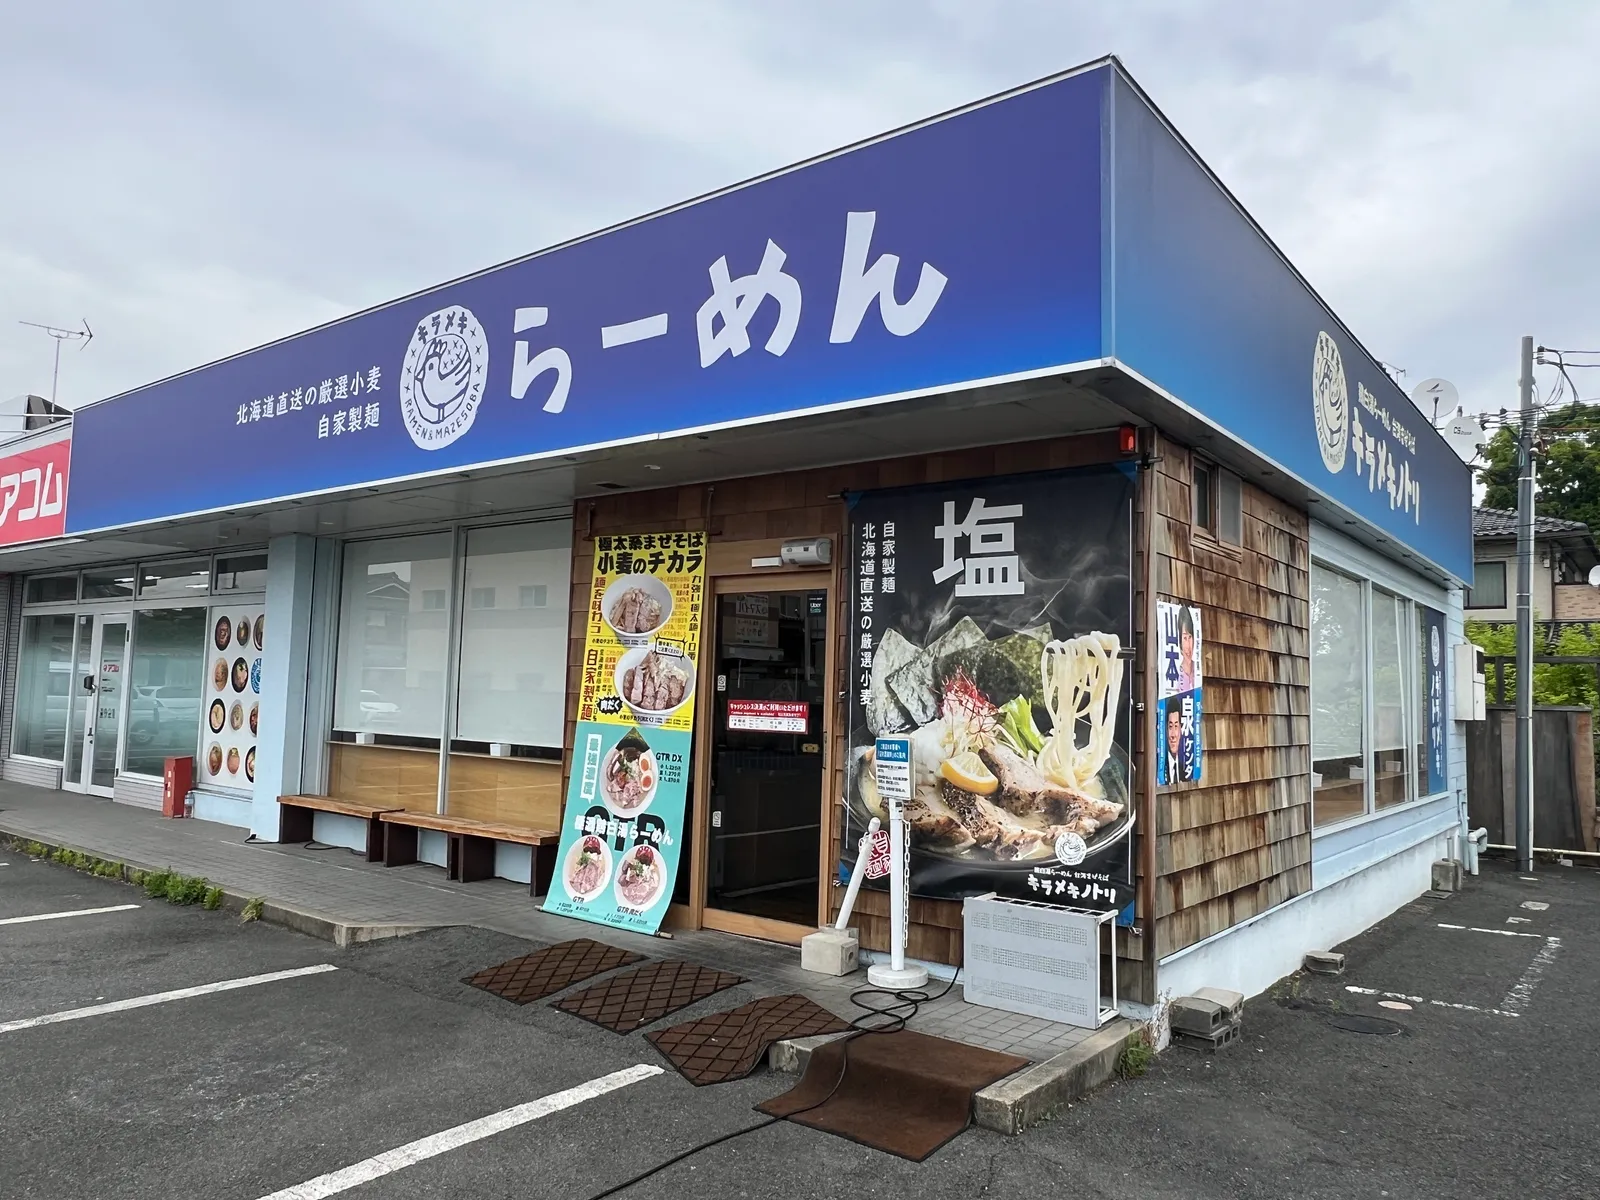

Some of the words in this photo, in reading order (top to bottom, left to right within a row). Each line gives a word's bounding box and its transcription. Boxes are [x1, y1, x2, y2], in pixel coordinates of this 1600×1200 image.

[417, 311, 468, 344] キラメキ
[511, 211, 948, 414] らーめん
[236, 365, 382, 425] 北海道直送の厳選小麦
[317, 402, 380, 439] 自家製麺
[0, 462, 63, 527] アコム
[1352, 407, 1420, 525] キラメキノトリ
[597, 550, 703, 575] 小麦のチカラ
[881, 521, 895, 594] 自家製麺
[932, 497, 1025, 597] 塩
[860, 522, 876, 706] 北海道直送の厳選小麦
[1165, 607, 1180, 688] 山本
[656, 752, 670, 762] GTR
[672, 753, 683, 763] DX
[1027, 873, 1117, 904] キラメキノトリ
